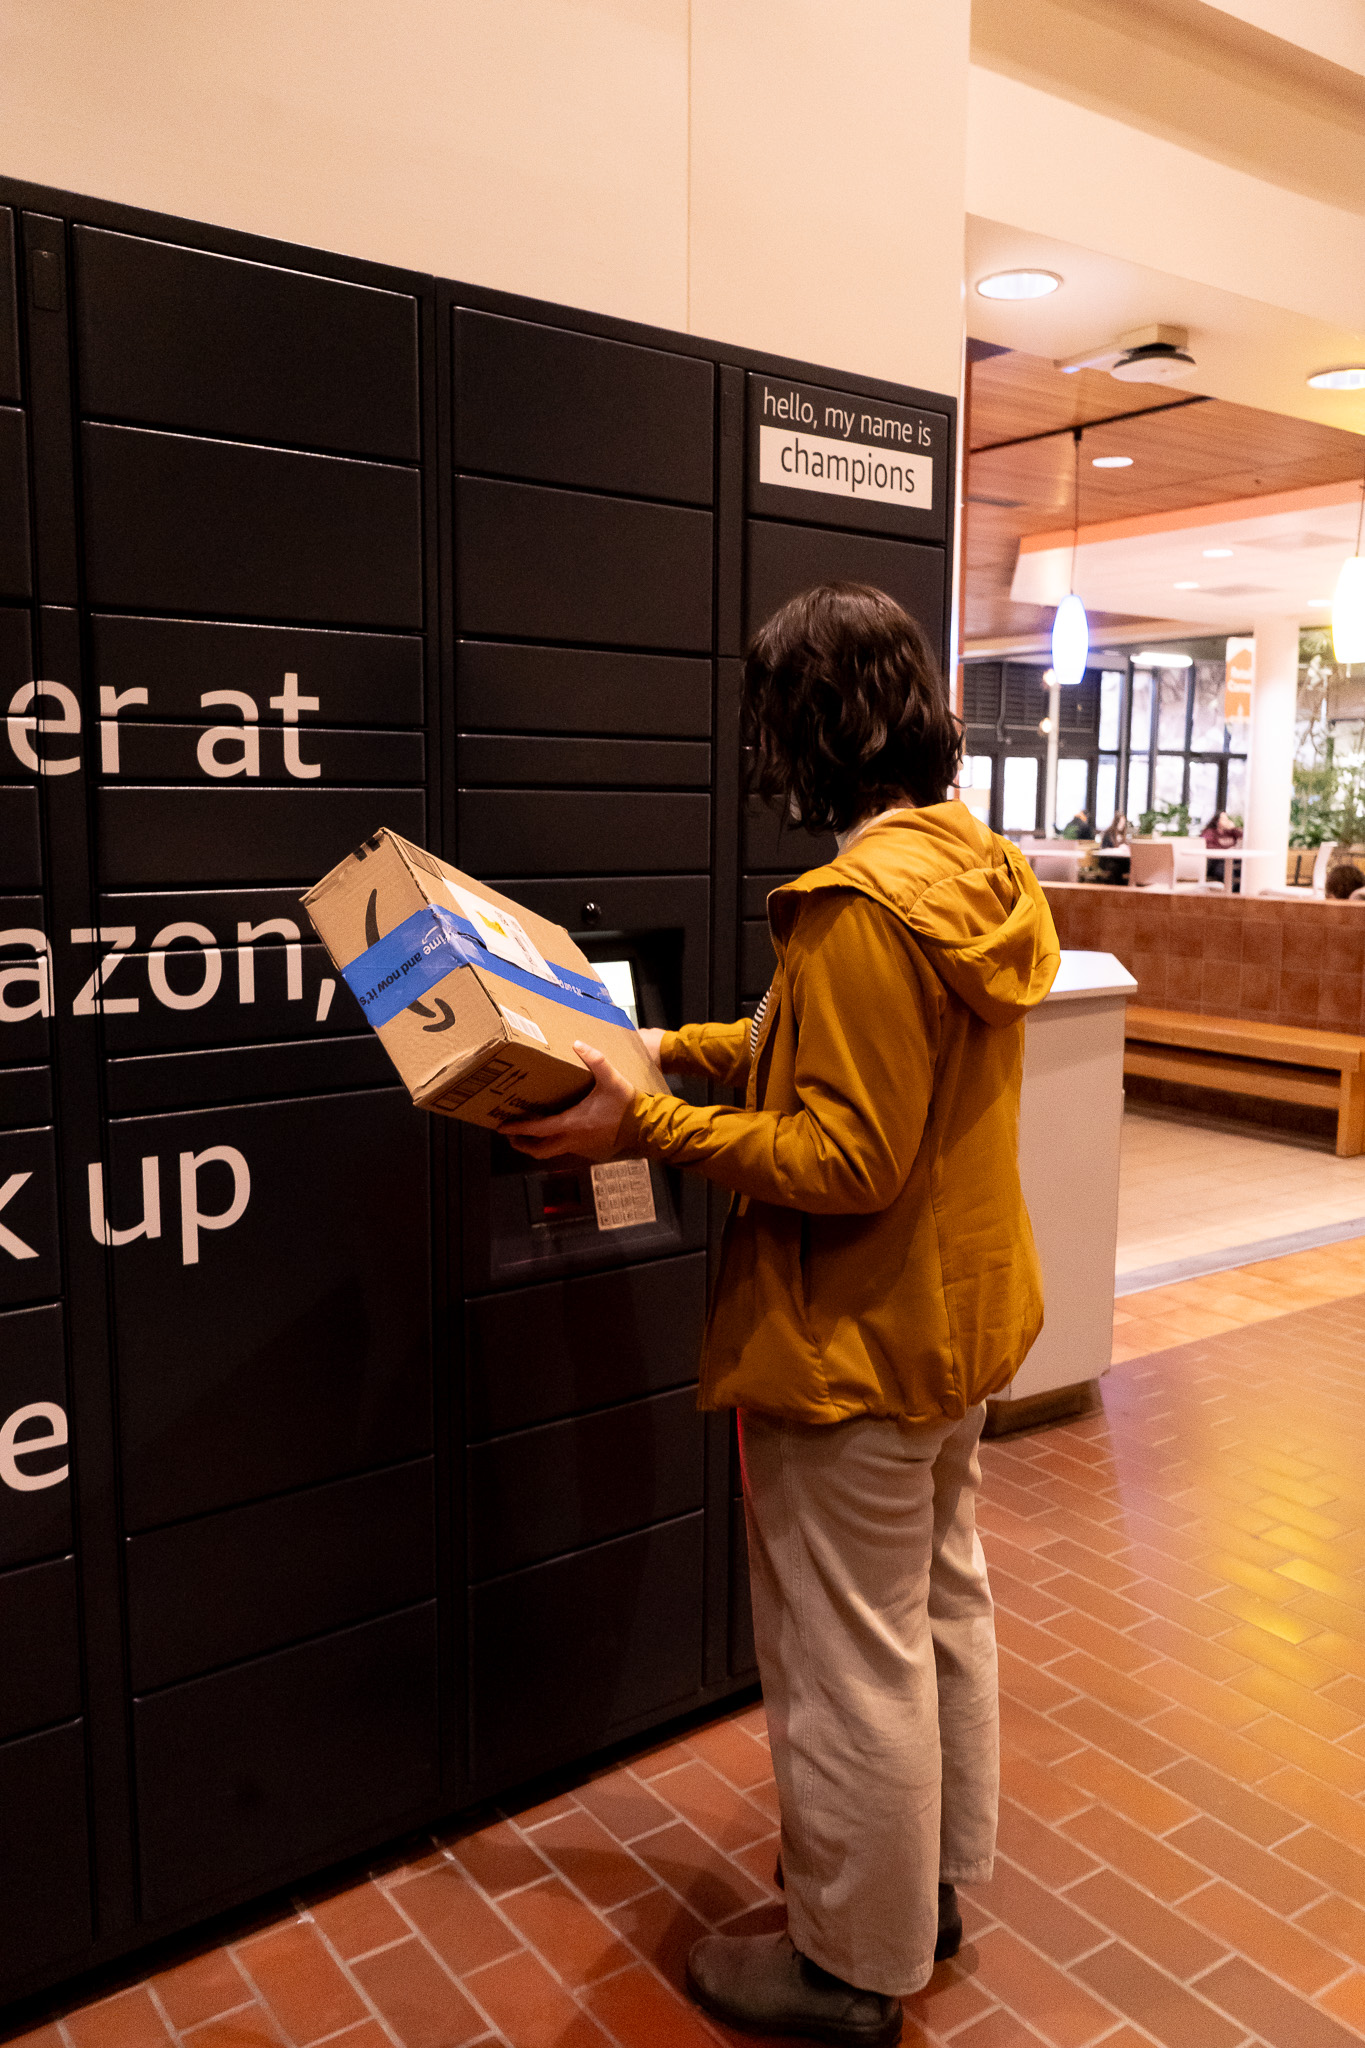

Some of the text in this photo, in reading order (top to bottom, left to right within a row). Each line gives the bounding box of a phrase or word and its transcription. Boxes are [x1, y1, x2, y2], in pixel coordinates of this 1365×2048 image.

[763, 387, 932, 447] hello, my name is
[781, 437, 916, 493] champions
[7, 672, 326, 779] er at
[0, 917, 336, 1023] azon,
[377, 970, 402, 994] now
[400, 952, 423, 976] and
[359, 988, 379, 1006] it's
[88, 1145, 251, 1265] up
[0, 1401, 69, 1492] e
